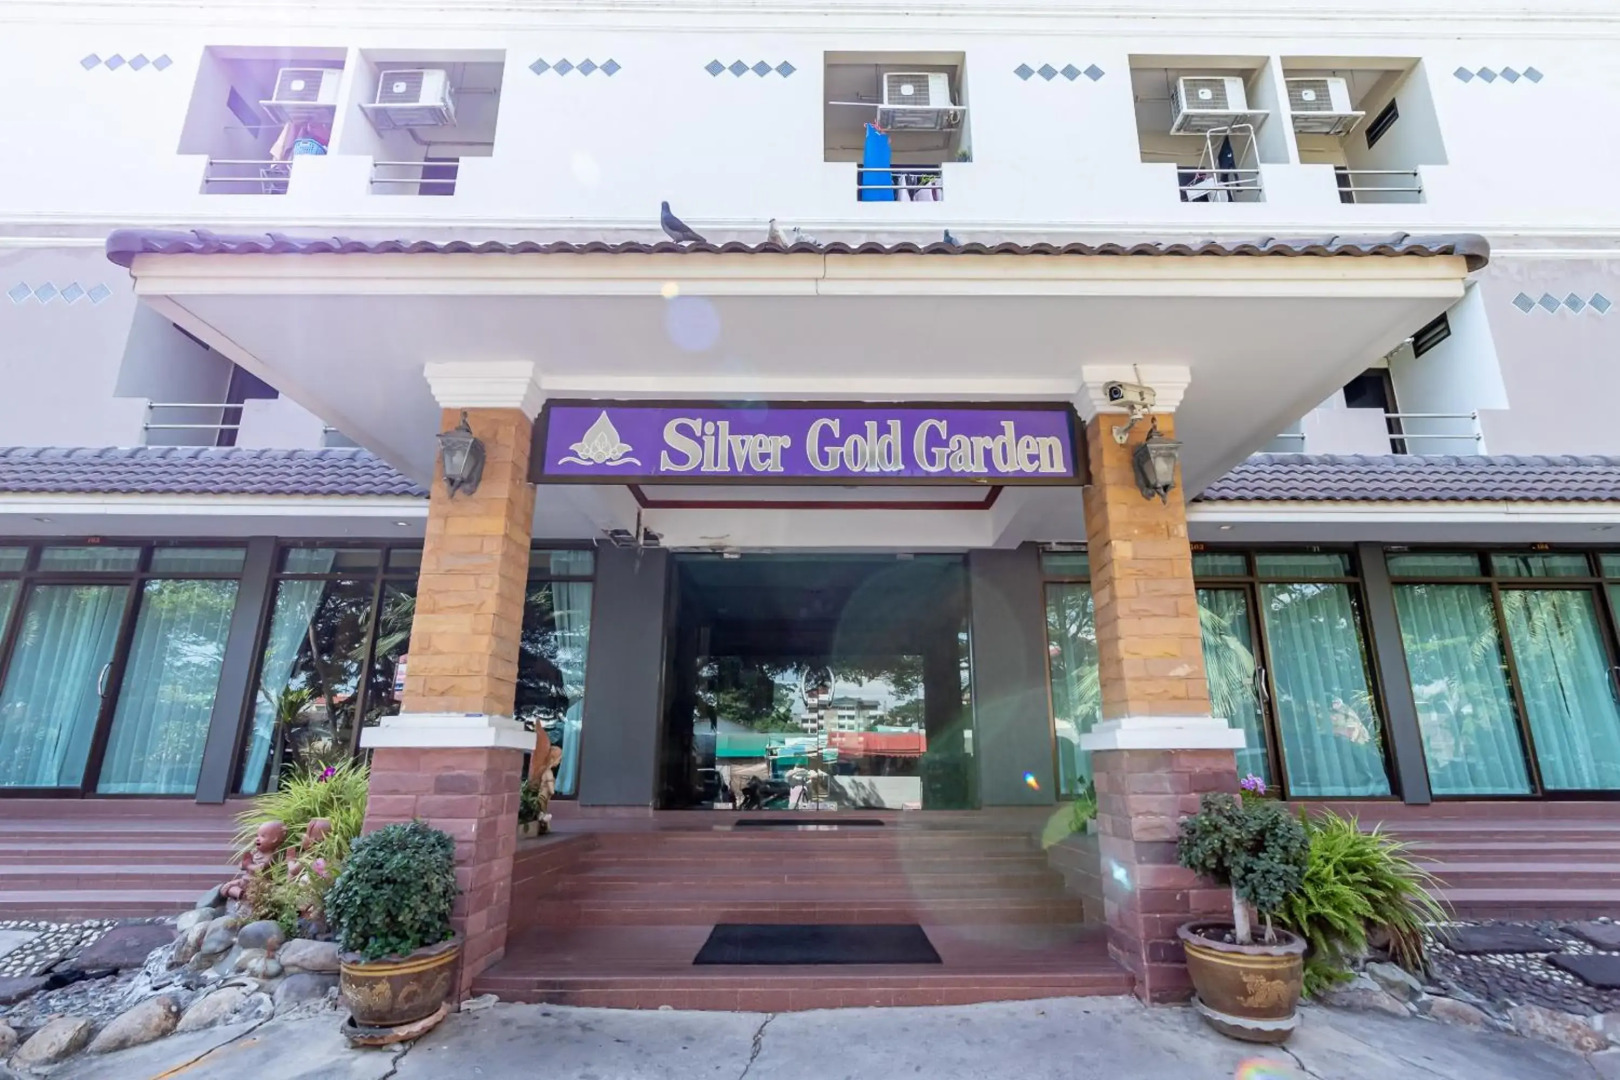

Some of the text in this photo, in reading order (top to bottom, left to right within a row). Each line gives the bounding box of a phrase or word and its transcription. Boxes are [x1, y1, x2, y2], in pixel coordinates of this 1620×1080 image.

[660, 417, 1067, 473] Silver Gold Garden
